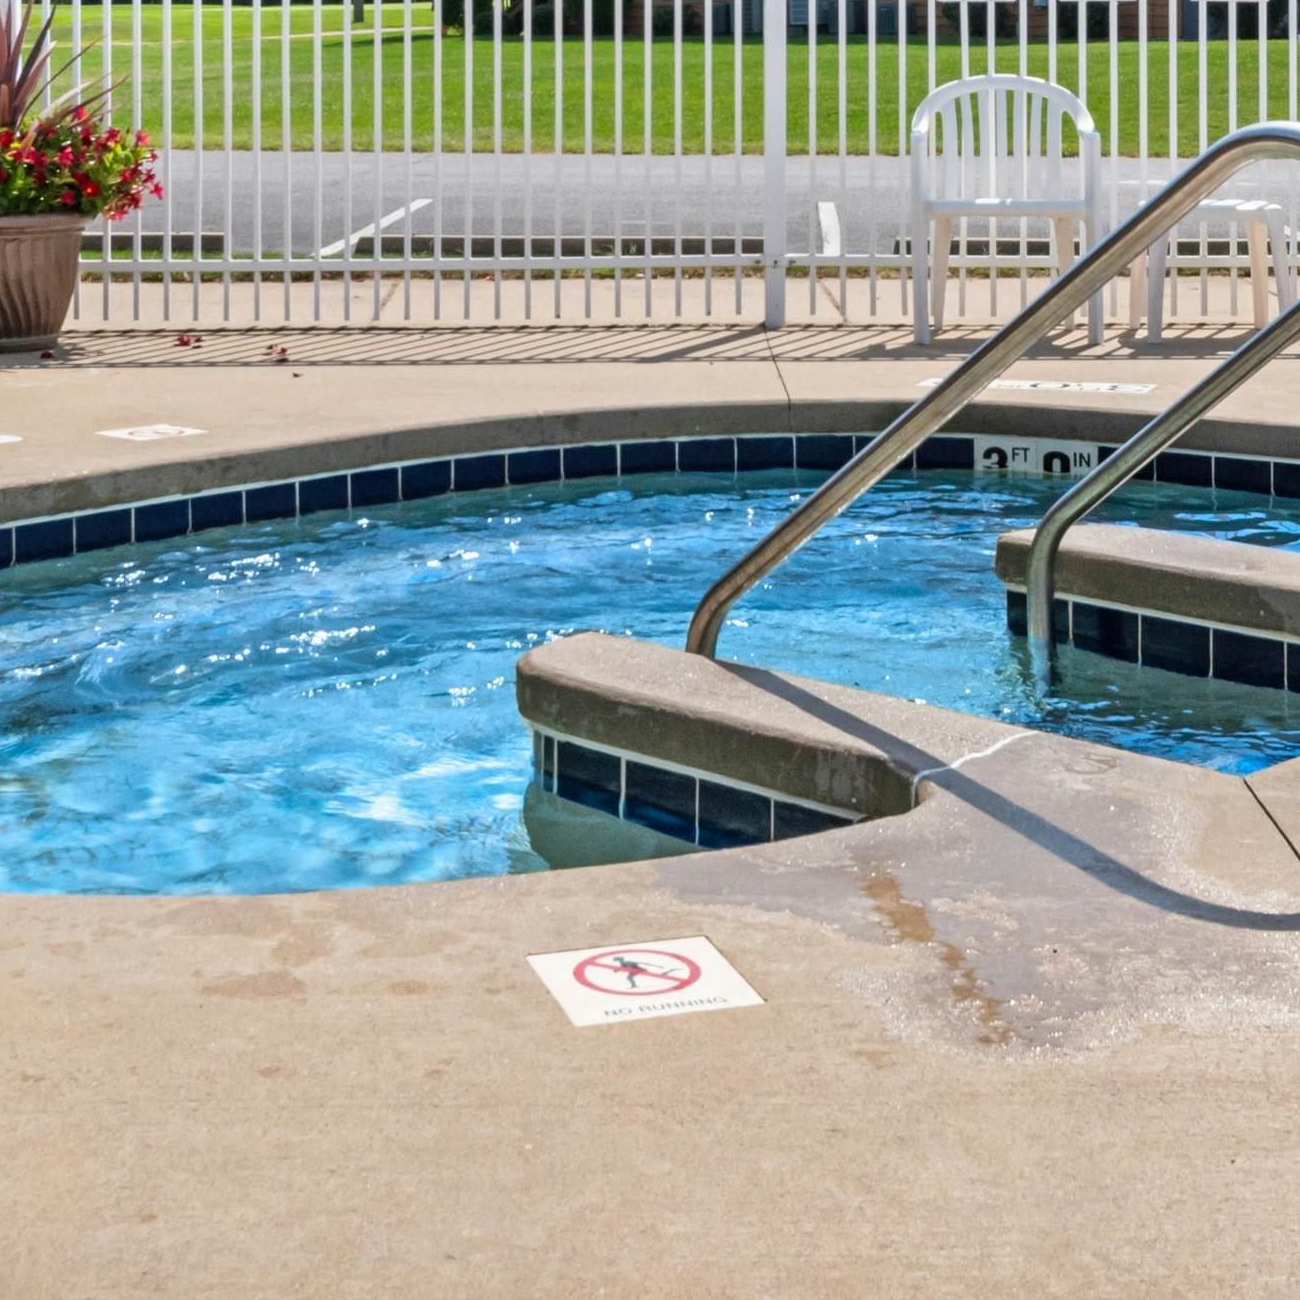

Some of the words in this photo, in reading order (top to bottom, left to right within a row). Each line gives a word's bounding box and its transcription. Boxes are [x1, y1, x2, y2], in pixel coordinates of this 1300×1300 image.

[982, 446, 1009, 469] 3
[1012, 447, 1030, 463] FT
[1043, 450, 1071, 474] 0
[1073, 451, 1091, 467] IN
[604, 1006, 634, 1018] NO
[638, 996, 728, 1013] RUNNING
